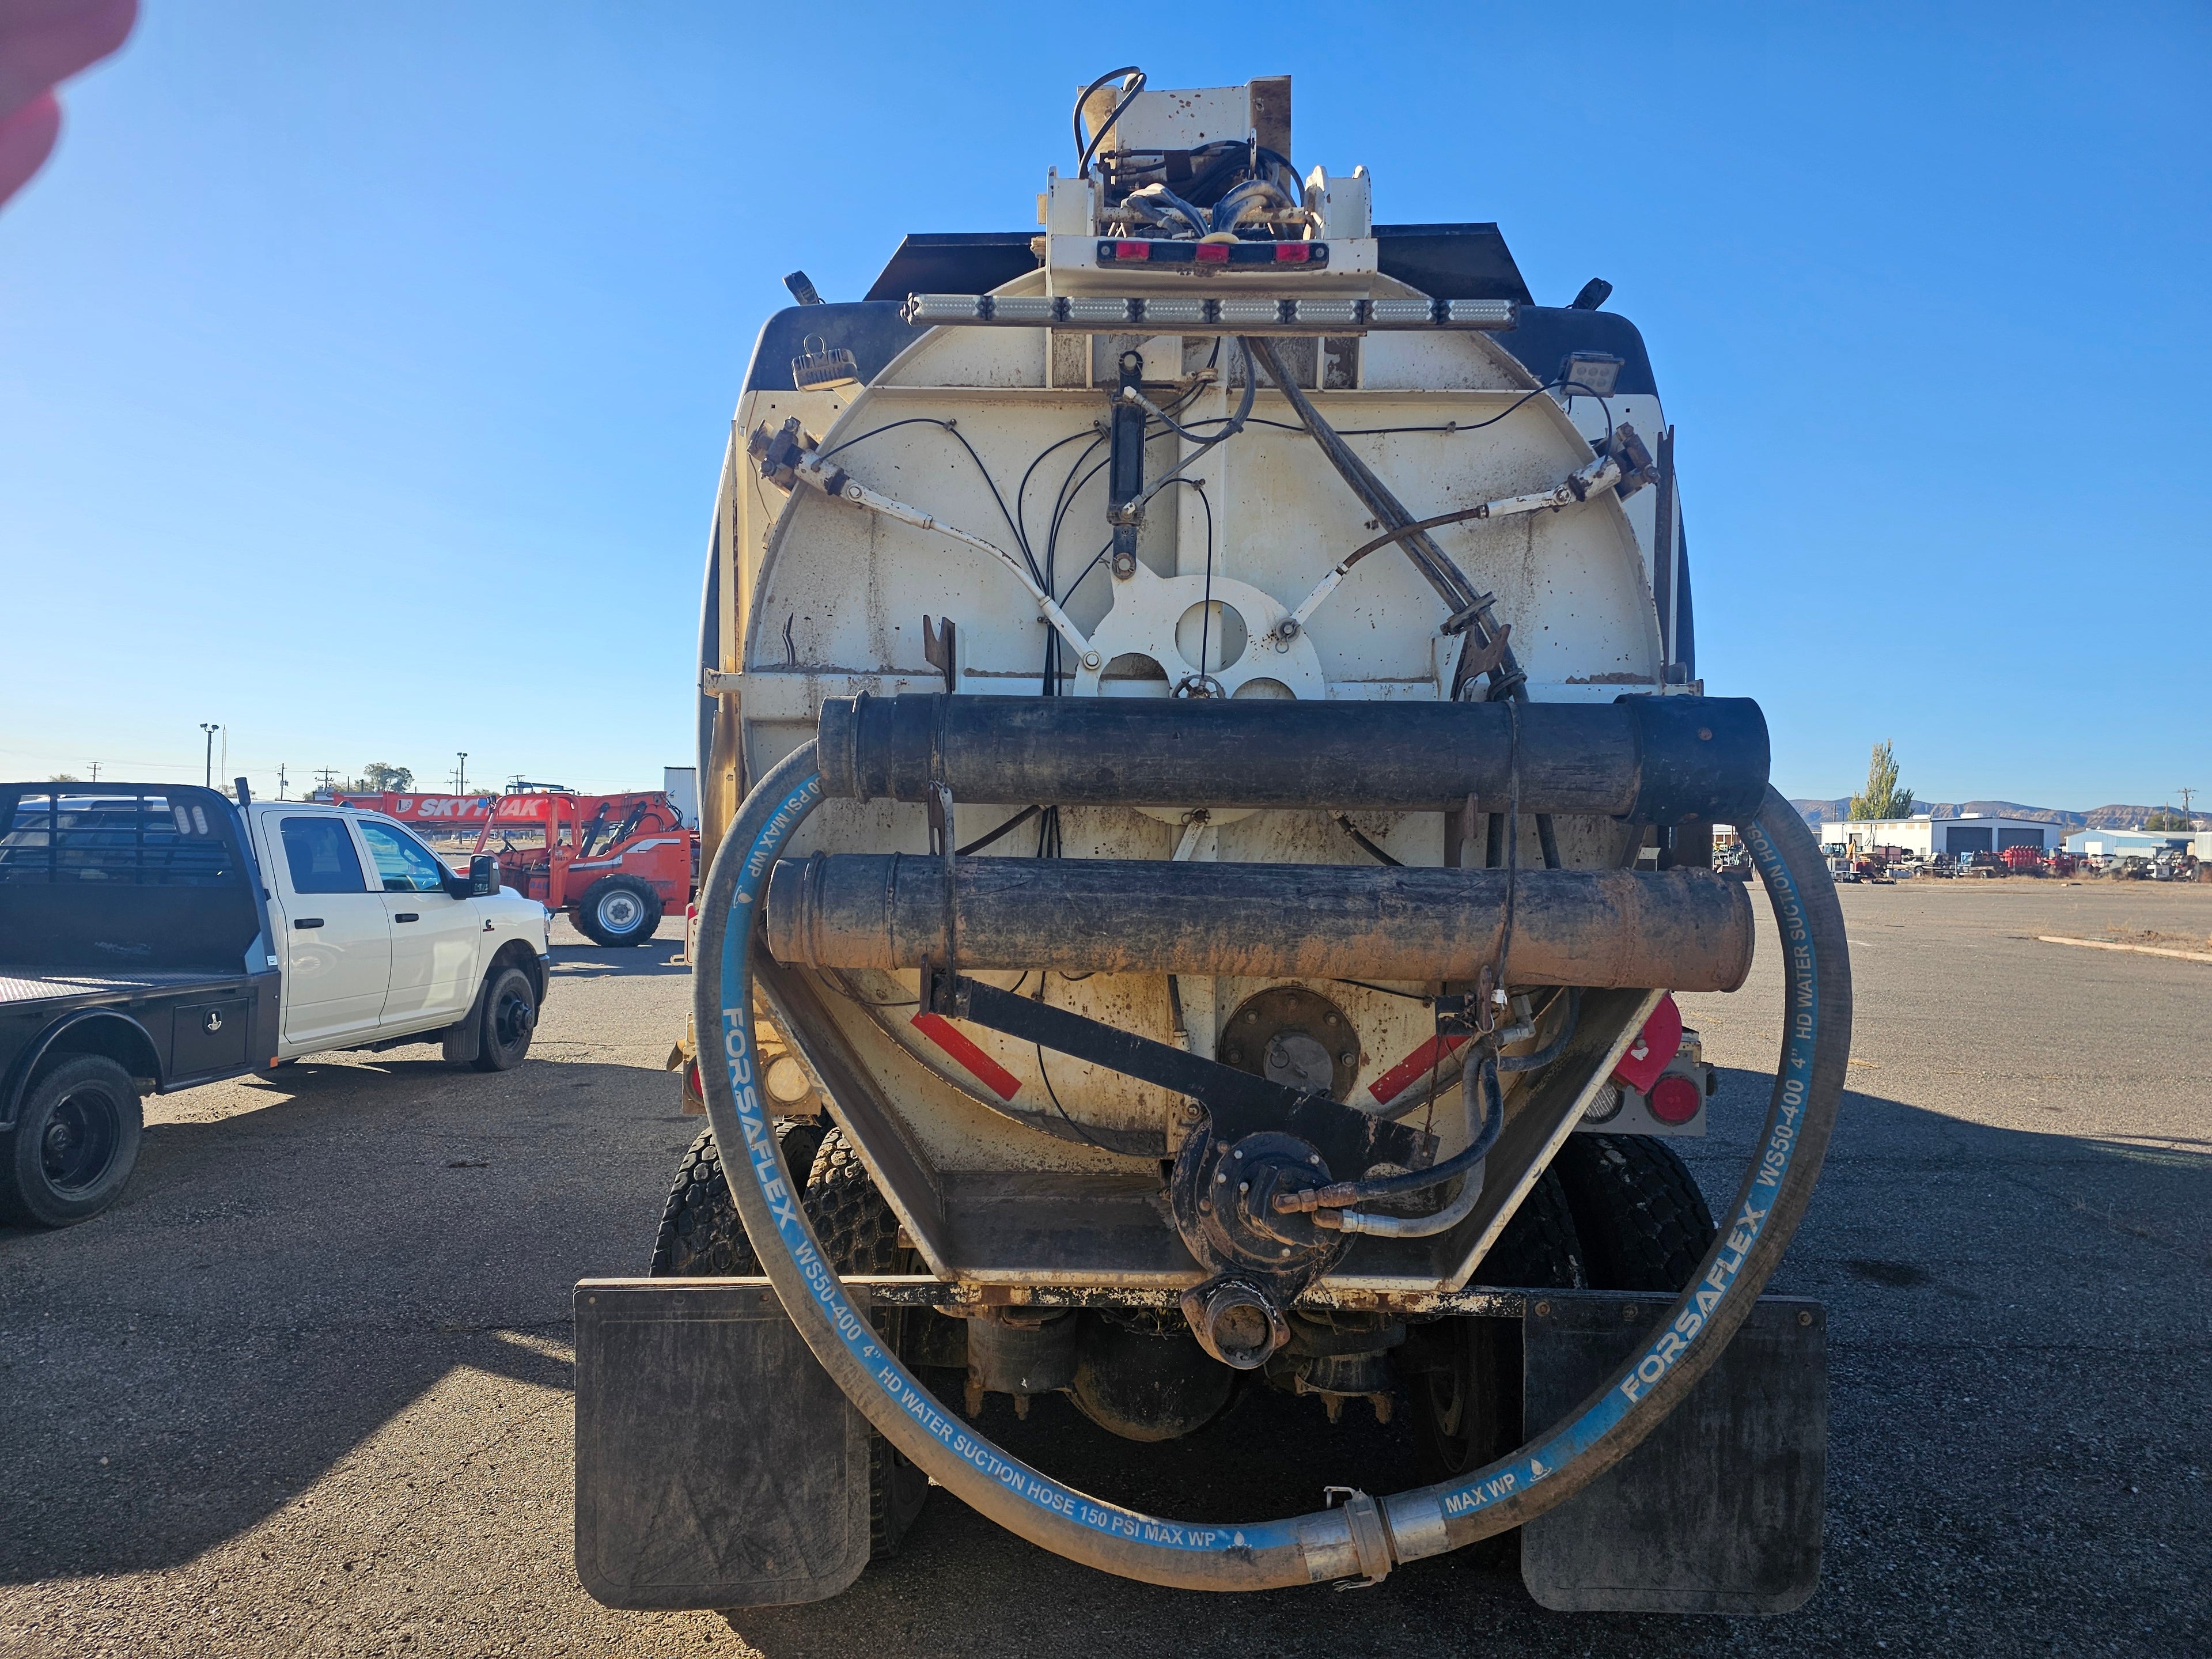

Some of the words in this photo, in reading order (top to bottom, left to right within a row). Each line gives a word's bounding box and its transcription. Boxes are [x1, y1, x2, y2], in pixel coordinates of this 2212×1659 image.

[784, 790, 810, 815] PSI
[759, 812, 791, 849] MAX
[748, 852, 768, 877] WP
[1770, 864, 1806, 940] SUCTION
[1794, 946, 1811, 1007] WATER
[1796, 1012, 1811, 1040] HD
[1756, 1079, 1804, 1187] WS50-400
[723, 1007, 797, 1230] FORSAFLEX
[794, 1240, 862, 1340] WS50-400
[878, 1366, 902, 1392] HD
[901, 1389, 954, 1441] WATER
[953, 1434, 1025, 1490] SUCTION
[1027, 1476, 1075, 1516] HOSE
[1080, 1506, 1107, 1528] 150
[1112, 1516, 1140, 1537] PSI
[1145, 1525, 1184, 1546] MAX
[1188, 1532, 1215, 1547] WP
[1620, 1200, 1767, 1403] FORSAFLEX
[1444, 1486, 1487, 1514] MAX
[1486, 1473, 1516, 1498] WP
